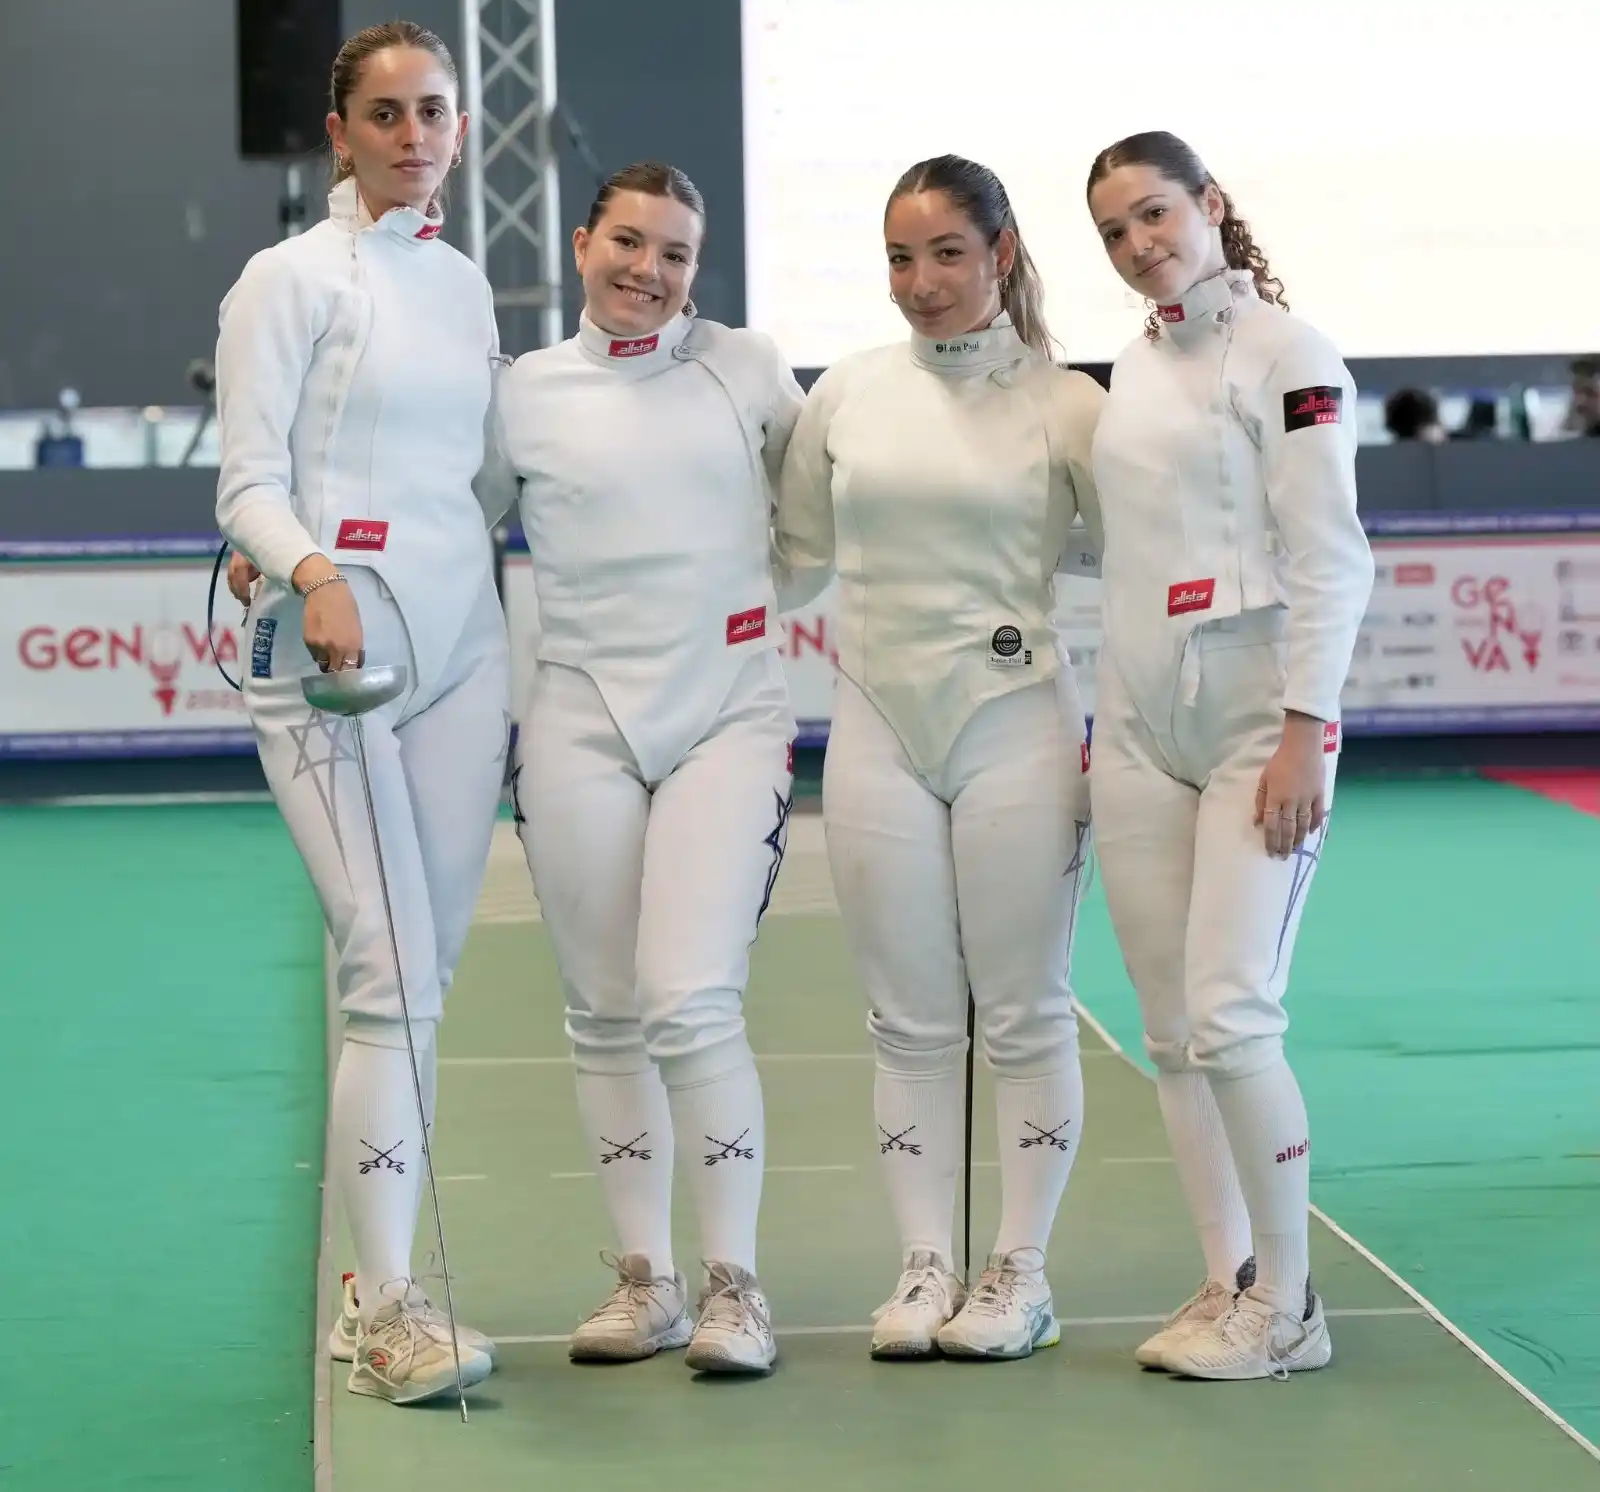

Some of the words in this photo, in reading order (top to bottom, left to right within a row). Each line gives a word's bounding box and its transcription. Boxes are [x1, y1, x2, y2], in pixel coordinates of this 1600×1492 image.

[617, 342, 656, 355] allstar
[964, 341, 979, 350] Paul
[344, 528, 383, 541] allstar
[1172, 590, 1208, 605] allstar
[732, 619, 763, 635] allstar
[1276, 1138, 1310, 1163] allst
